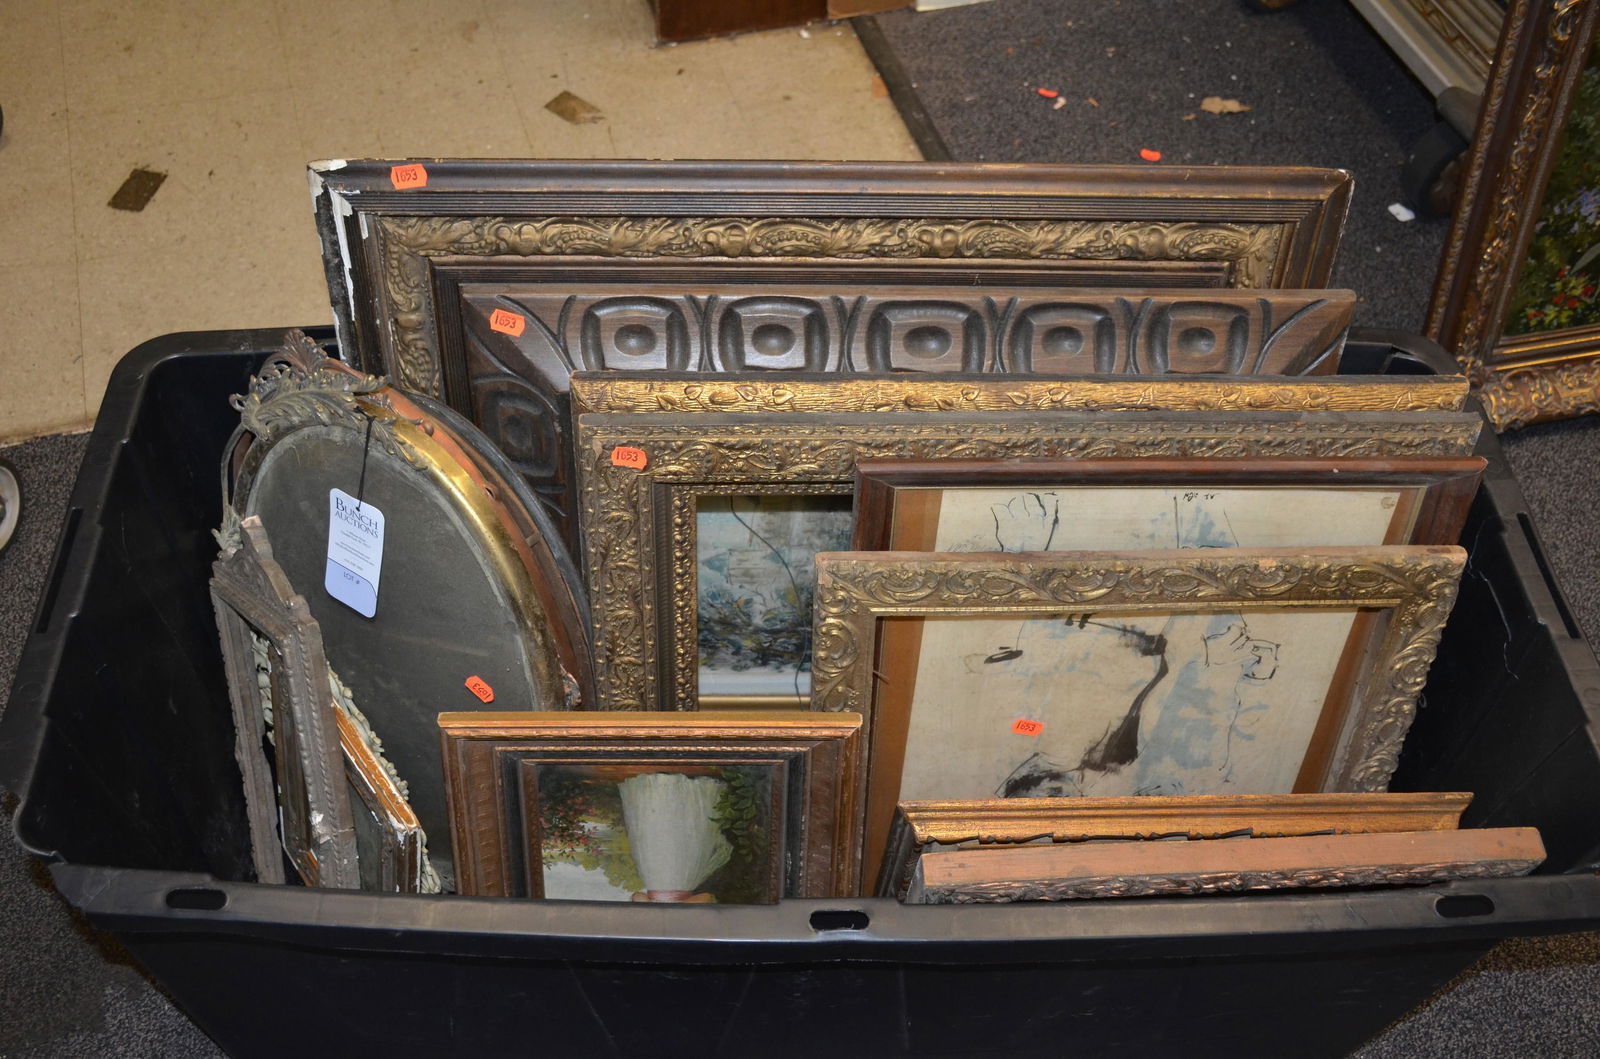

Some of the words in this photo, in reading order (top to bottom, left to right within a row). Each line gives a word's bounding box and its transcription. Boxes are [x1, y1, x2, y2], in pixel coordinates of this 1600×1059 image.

[396, 169, 418, 183] 1653
[495, 312, 517, 329] 1653
[616, 450, 638, 462] 1653
[336, 497, 378, 530] BUNCH
[335, 512, 379, 538] AUCTIONS
[472, 683, 491, 699] 1653
[1016, 721, 1036, 732] 1653
